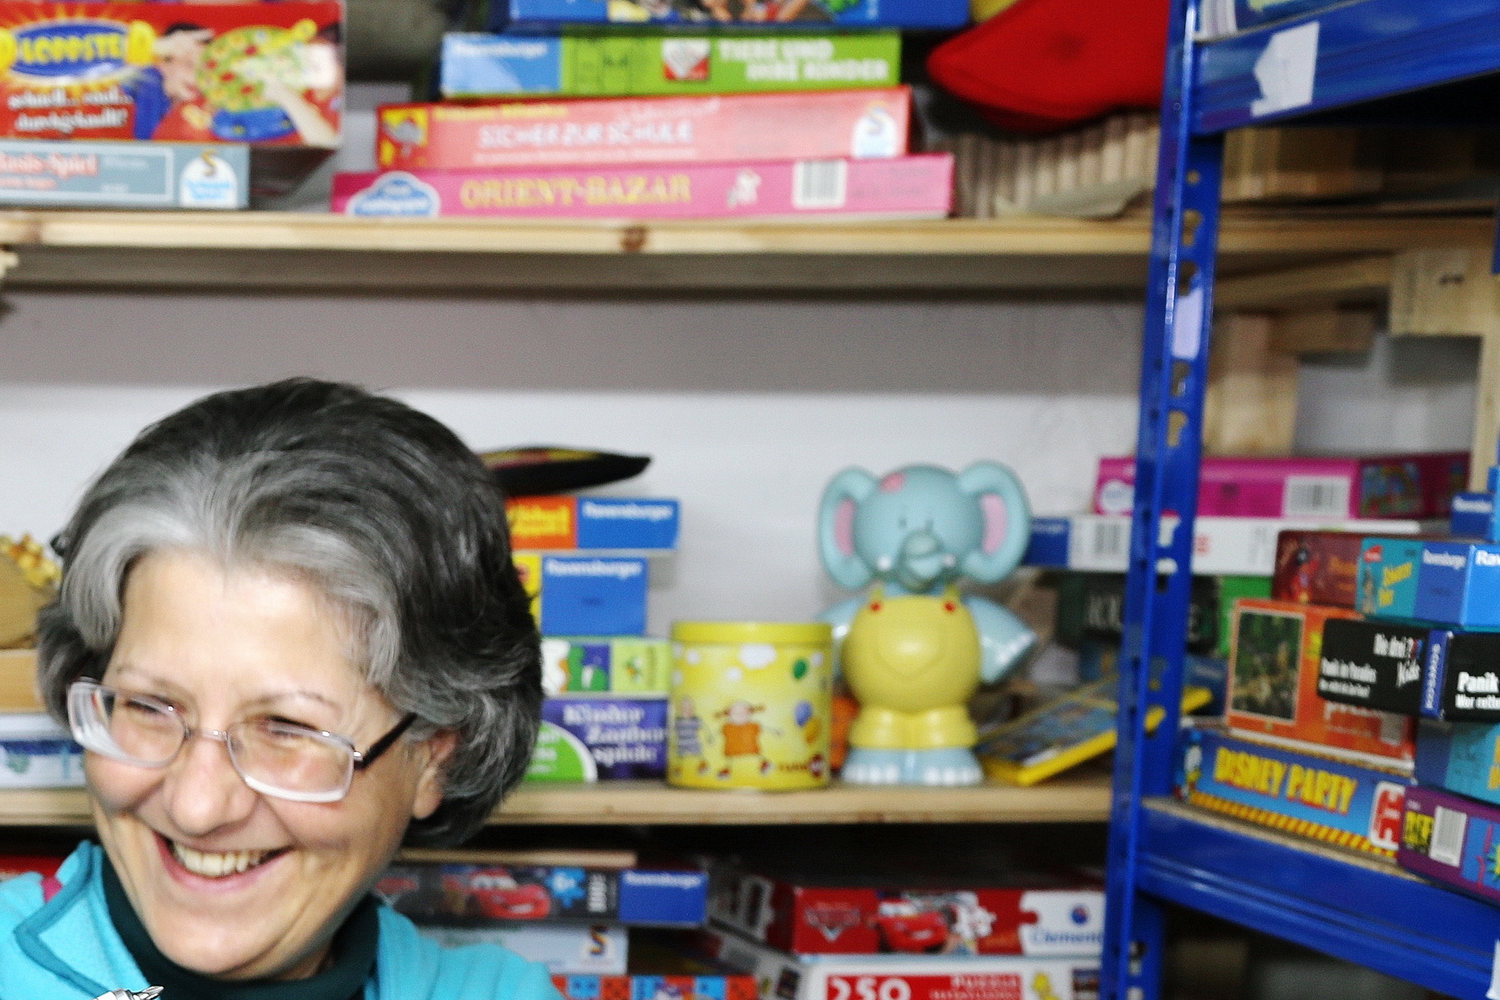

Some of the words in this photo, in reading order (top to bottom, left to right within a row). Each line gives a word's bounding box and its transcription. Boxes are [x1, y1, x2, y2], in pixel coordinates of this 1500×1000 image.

[717, 42, 781, 60] TIERE
[784, 40, 835, 59] UND
[745, 62, 799, 80] IHRE
[804, 60, 889, 80] KINDER
[607, 119, 694, 145] SCHULE
[459, 173, 692, 210] ORIENT-BAZAR
[1425, 643, 1442, 710] KOSMOS
[1457, 671, 1500, 692] Panik
[1213, 746, 1287, 798] DISNEY
[1286, 763, 1359, 816] PARTY
